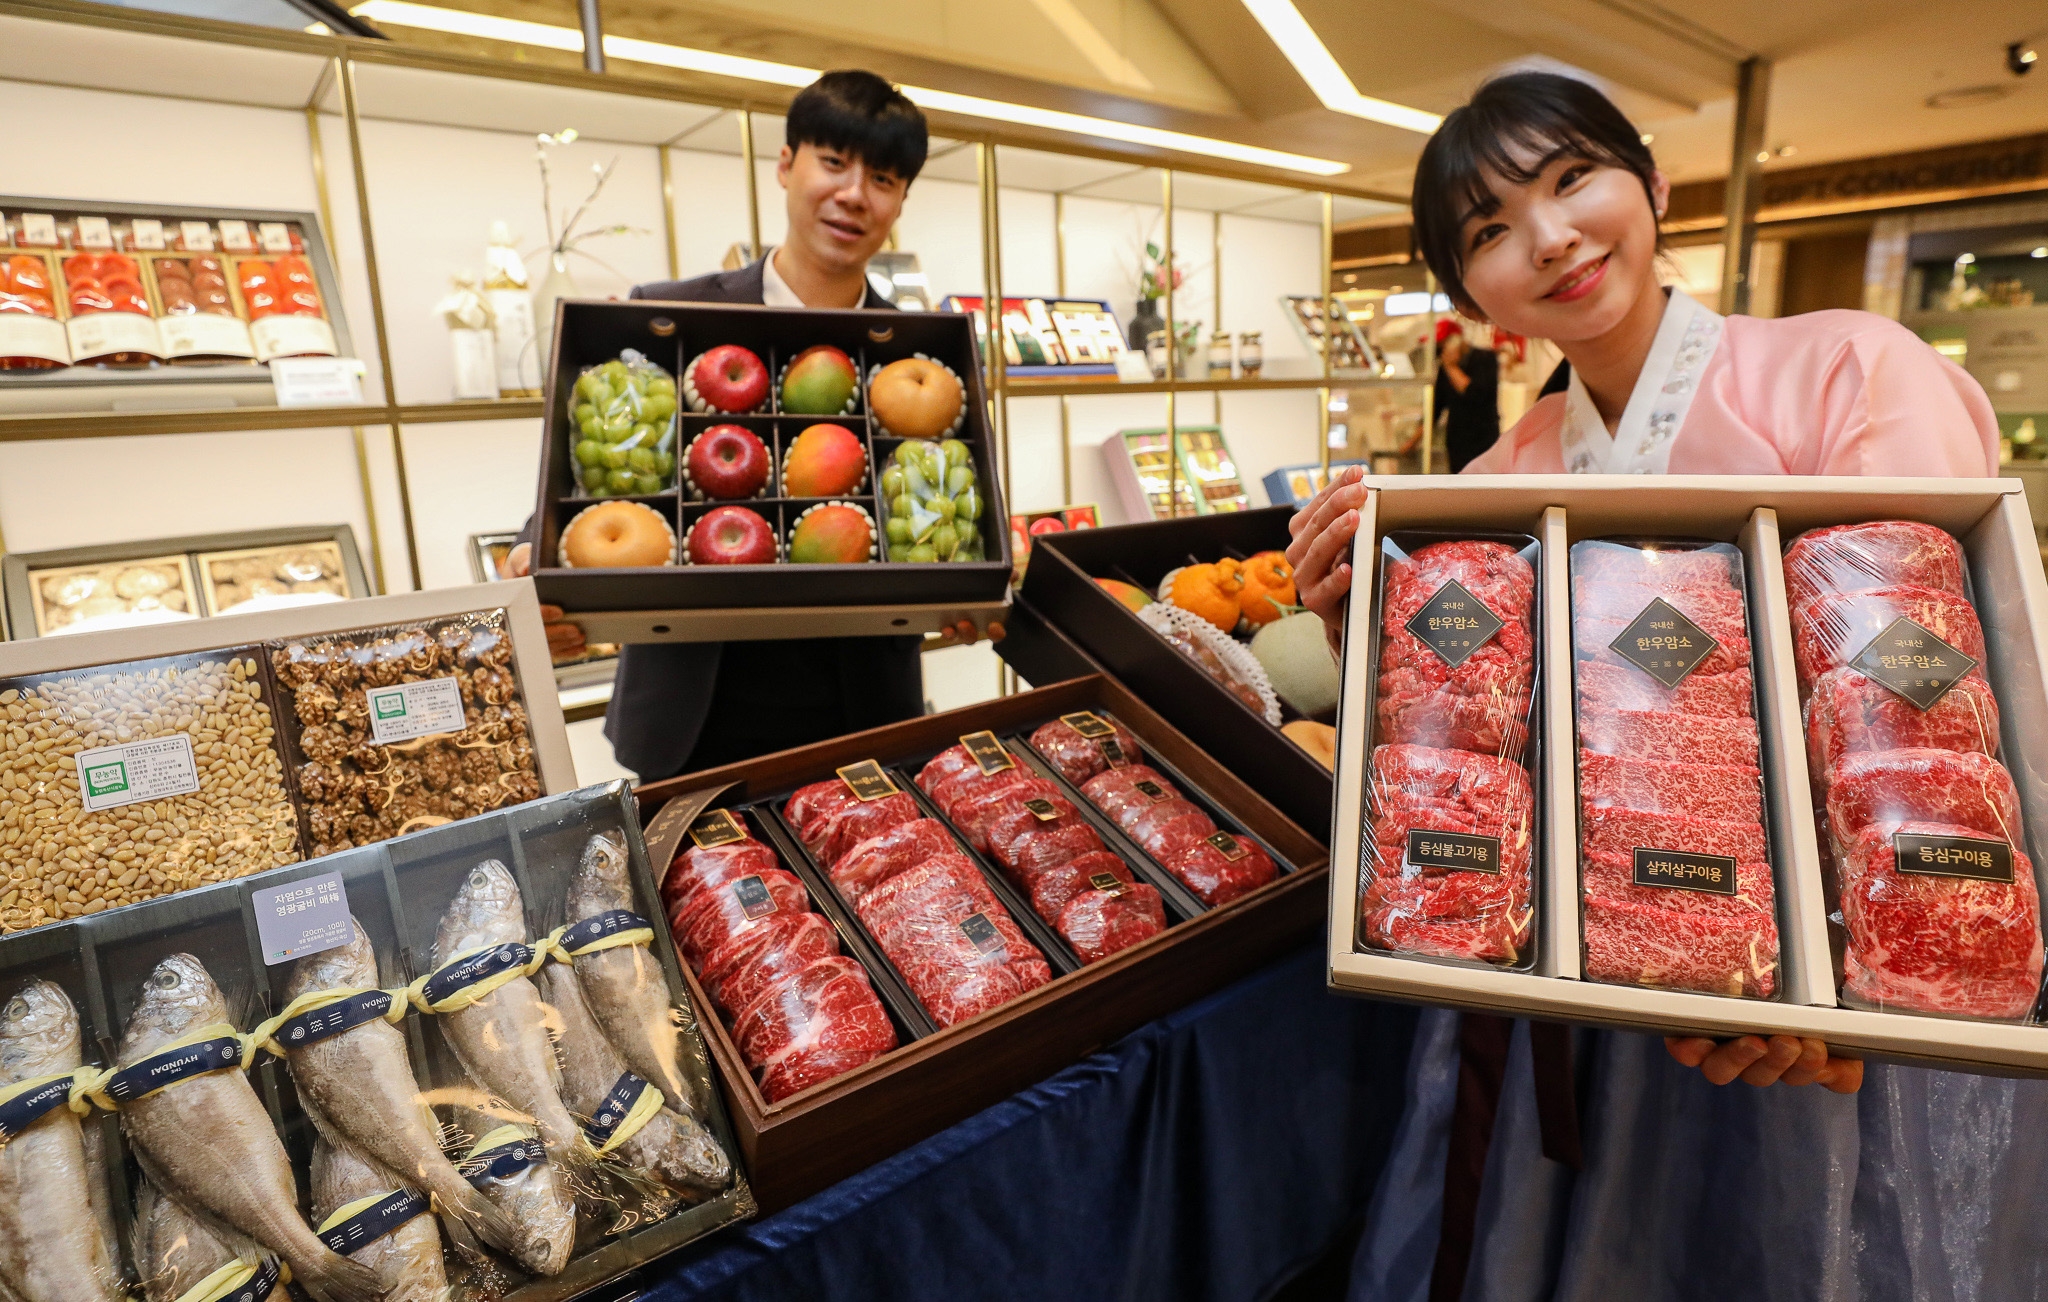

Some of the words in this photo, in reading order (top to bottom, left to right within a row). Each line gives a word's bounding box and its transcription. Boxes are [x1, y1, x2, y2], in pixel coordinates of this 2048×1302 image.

[1442, 602, 1464, 610] 국내산
[1429, 617, 1479, 630] 한우암소
[1650, 621, 1674, 630] 국내산
[1637, 636, 1692, 650] 한우암소
[1895, 640, 1923, 648] 국내산
[1881, 655, 1947, 669] 한우암소
[94, 768, 117, 779] 무농약
[1420, 842, 1488, 861] 등심불고기용
[1919, 847, 1993, 868] 등심구이용
[1647, 861, 1722, 882] 살치살구이용
[275, 887, 315, 904] 자염으로
[318, 881, 337, 894] 만든
[276, 898, 316, 916] 영광굴비
[302, 927, 326, 938] (20cm,
[328, 921, 345, 930] 10미)
[447, 963, 483, 982] HYUNDAI
[151, 1055, 198, 1076] HYUNDAI
[26, 1081, 73, 1106] HYUNDAI
[382, 1195, 421, 1216] HYUNDAI
